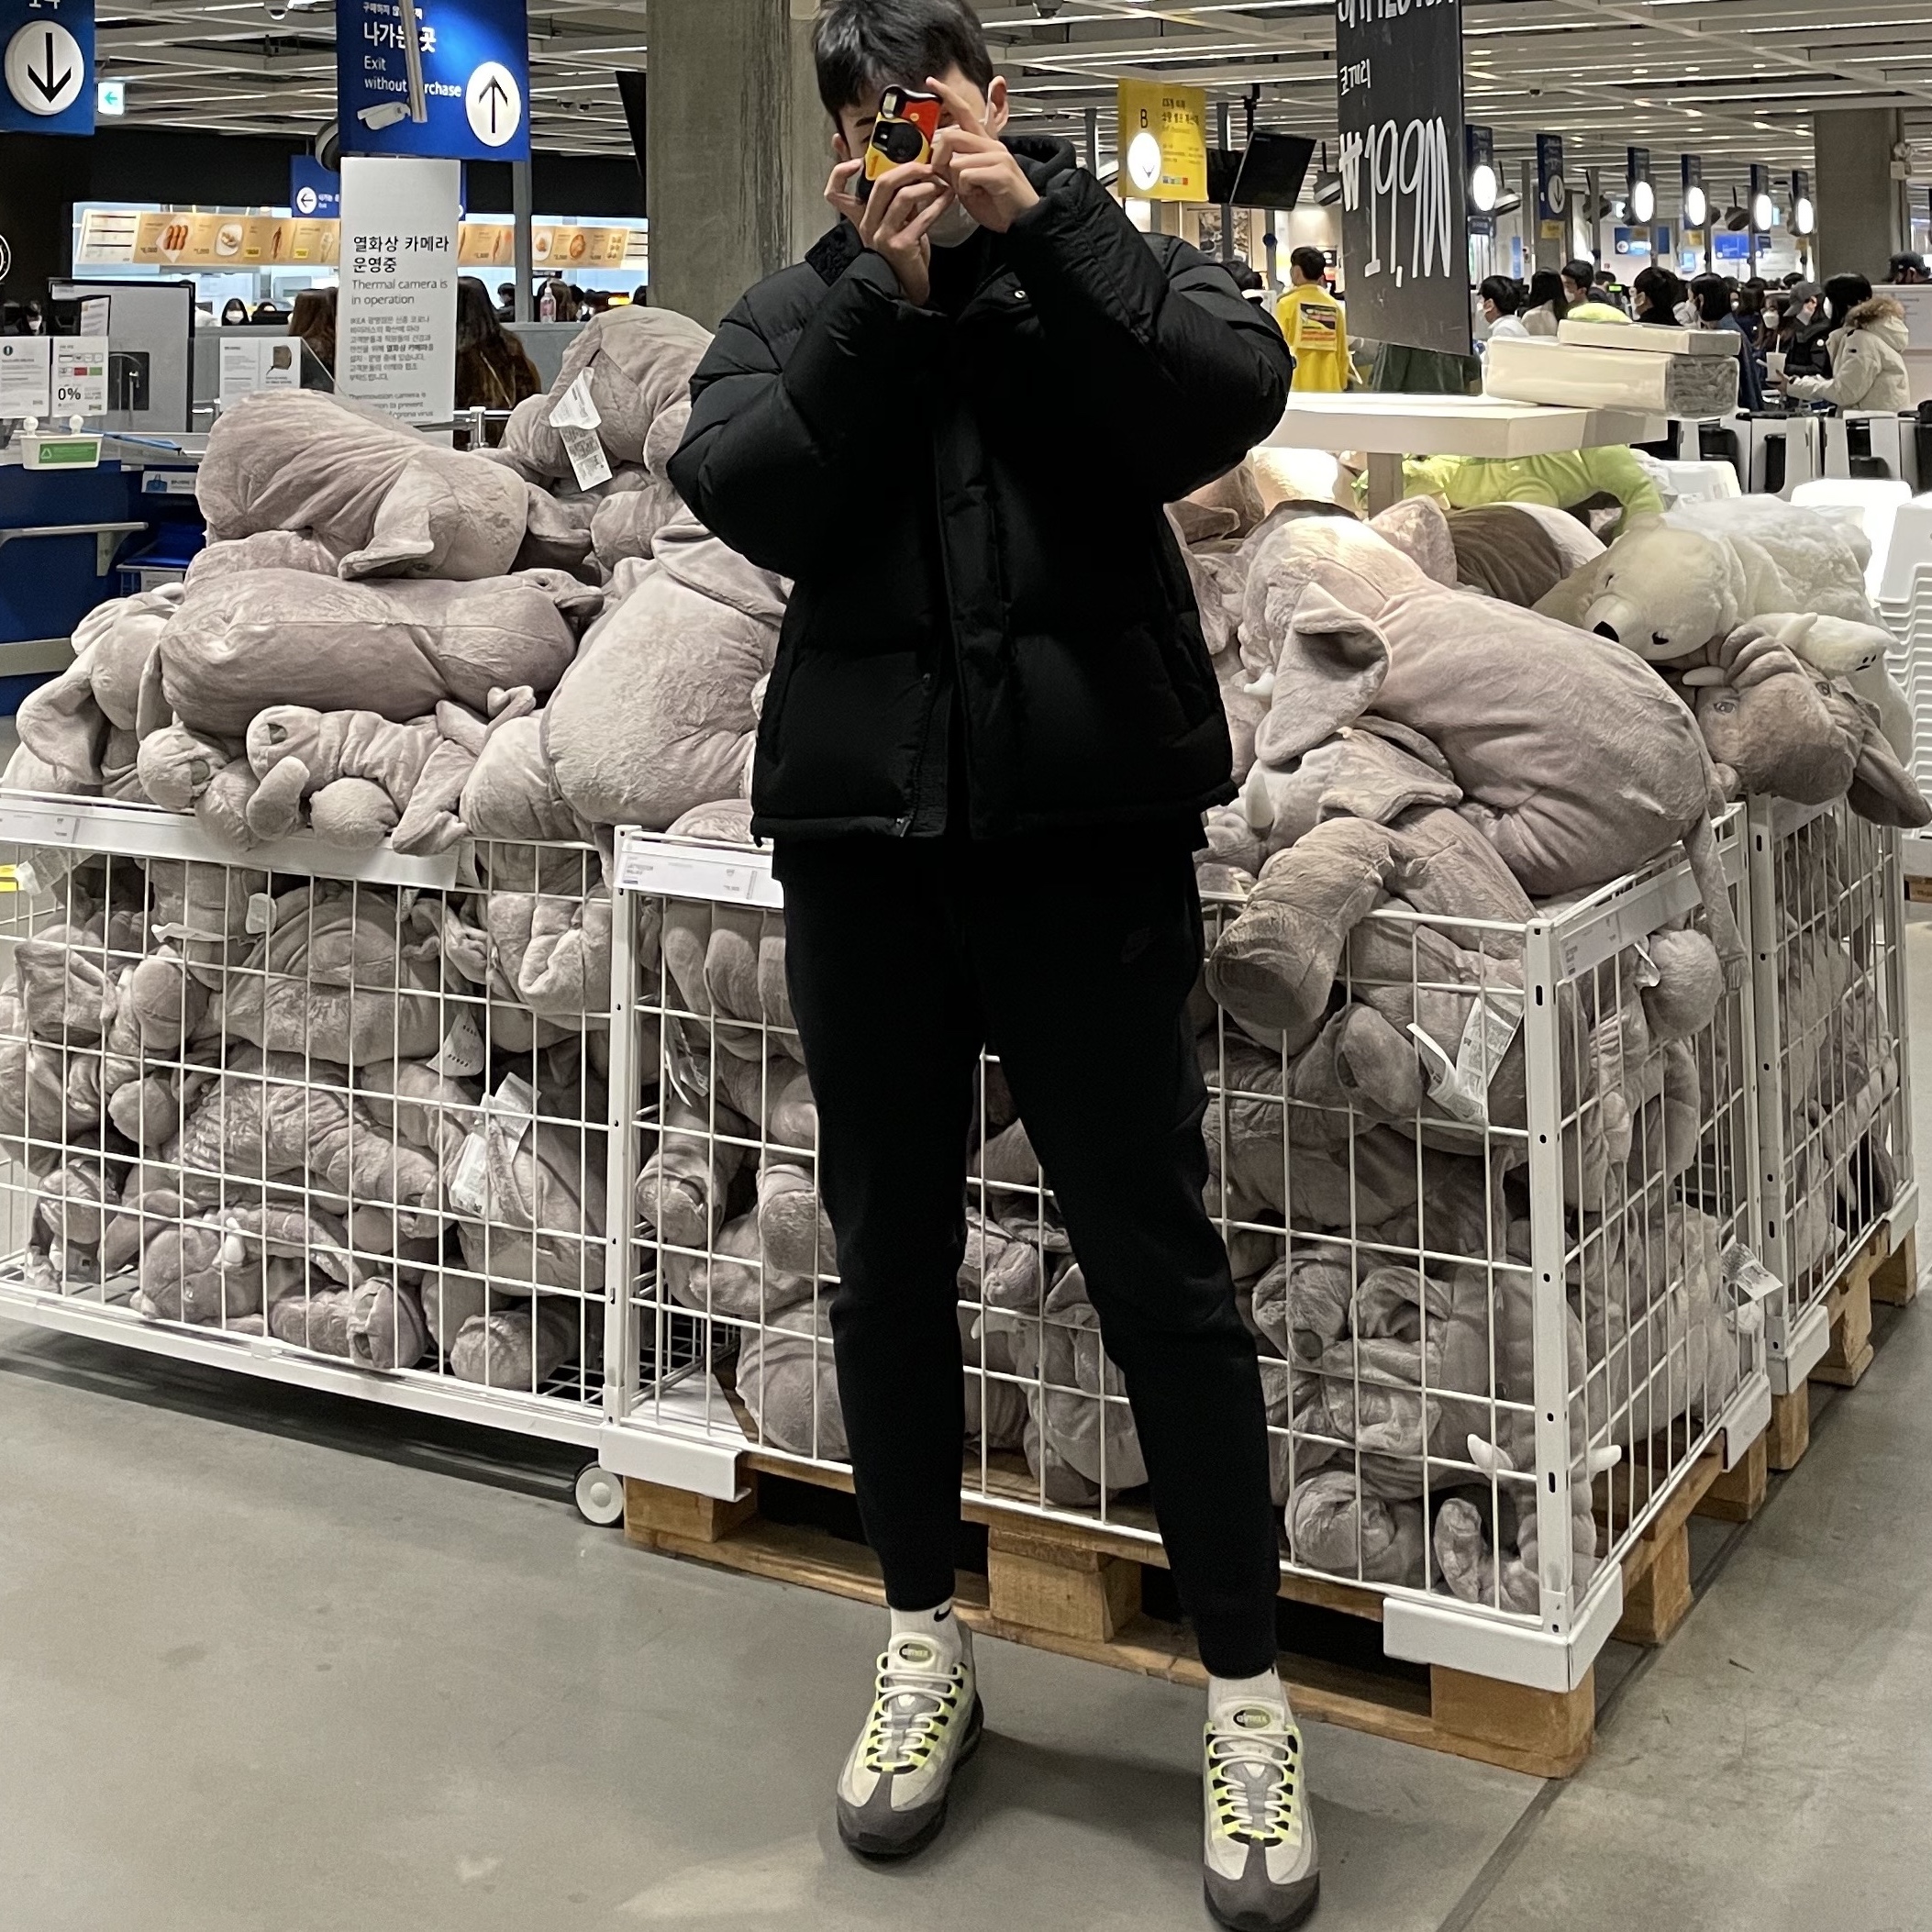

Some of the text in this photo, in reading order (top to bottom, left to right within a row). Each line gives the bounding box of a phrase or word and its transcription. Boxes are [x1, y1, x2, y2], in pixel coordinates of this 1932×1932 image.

[419, 27, 437, 52] 곳
[364, 55, 386, 72] Exit
[364, 76, 461, 97] without rchase
[1140, 108, 1149, 128] B
[353, 235, 450, 253] 열화상 카메라
[352, 256, 397, 273] 운영중
[352, 279, 449, 290] Thermal camera is
[351, 294, 415, 307] in operation
[58, 387, 82, 401] 0%
